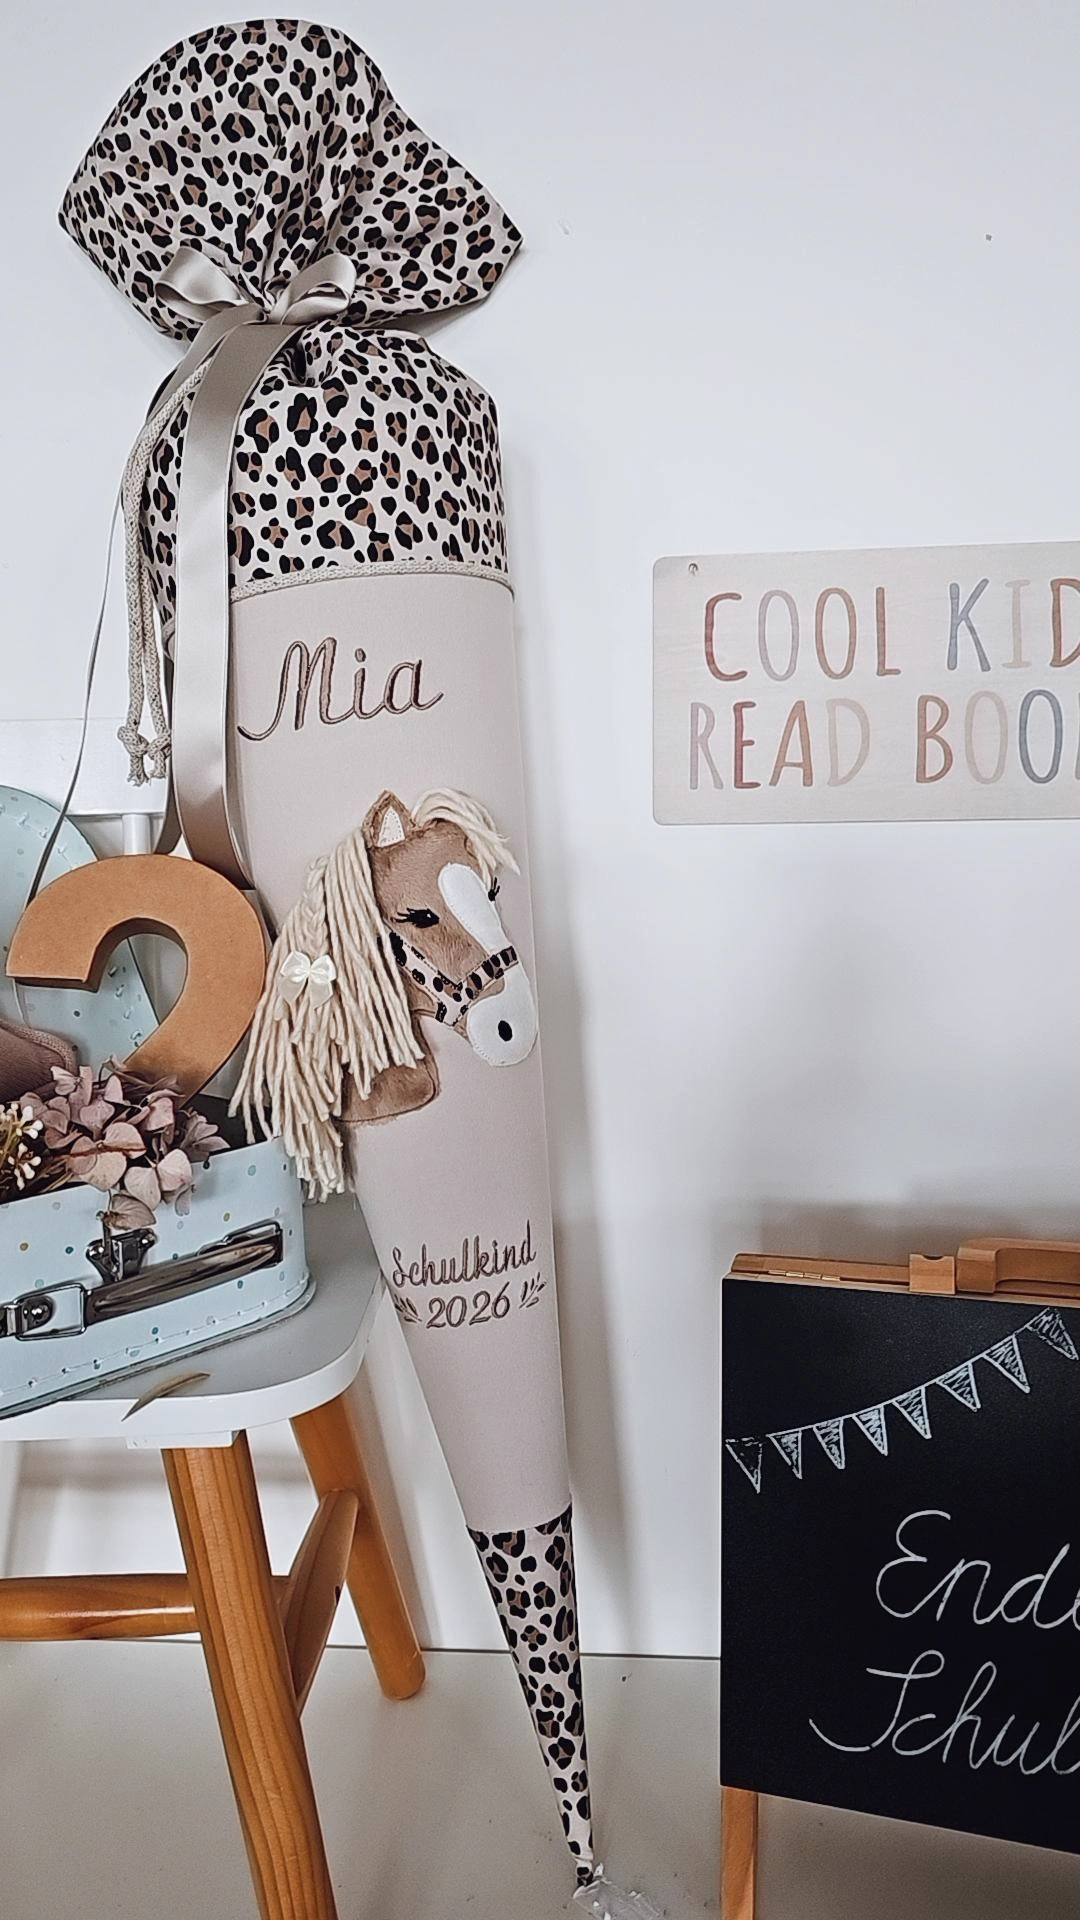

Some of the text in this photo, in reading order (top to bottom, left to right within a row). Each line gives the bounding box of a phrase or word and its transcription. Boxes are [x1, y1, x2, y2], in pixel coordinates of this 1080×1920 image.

[704, 586, 901, 681] COOL
[237, 636, 444, 741] Mia
[689, 689, 1080, 790] READ BOO
[392, 1219, 537, 1288] Schulkind
[426, 1281, 511, 1329] 2026
[876, 1509, 1080, 1630] End
